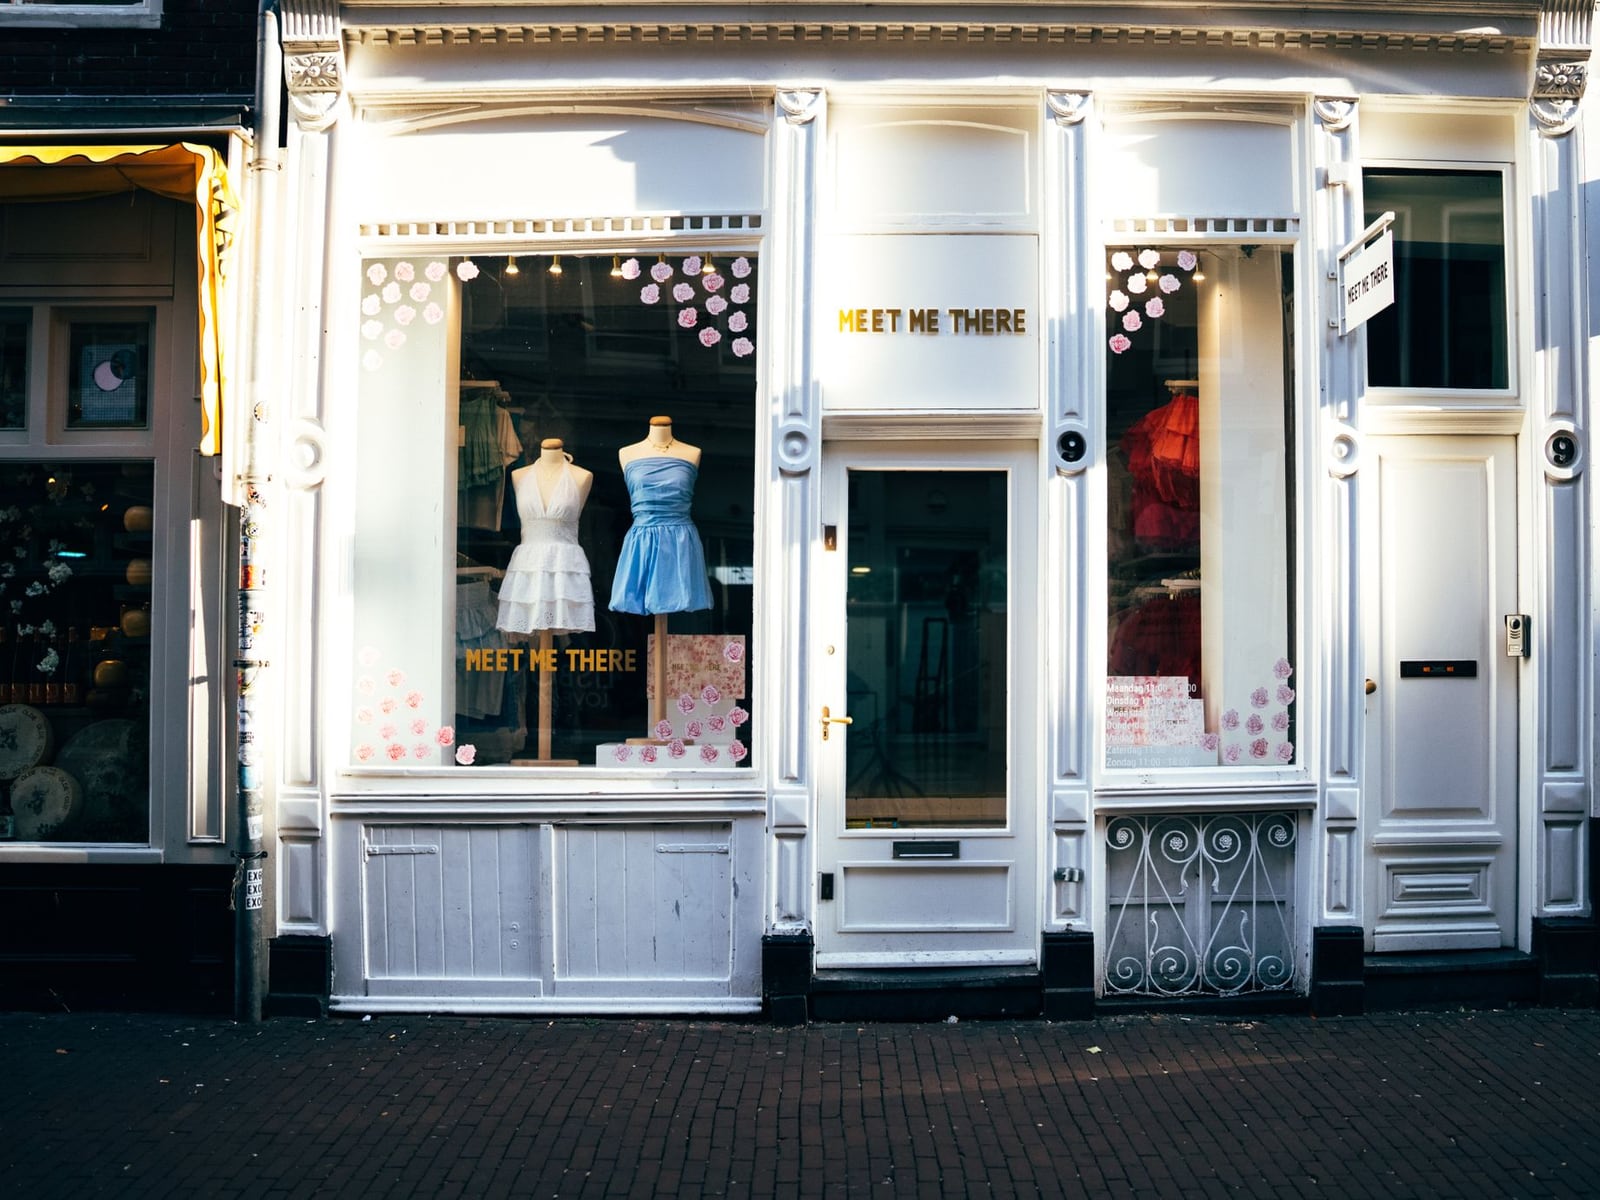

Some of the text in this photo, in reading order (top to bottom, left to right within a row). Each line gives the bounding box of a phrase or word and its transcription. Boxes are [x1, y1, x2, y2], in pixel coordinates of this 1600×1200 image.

[1348, 261, 1388, 304] MEET ME THERE
[838, 309, 1026, 333] MEET ME THERE
[1060, 431, 1084, 461] 9
[1552, 436, 1574, 464] 9
[465, 648, 636, 672] MEET ME THERE
[1107, 684, 1144, 694] Maandag
[1106, 757, 1136, 768] Zondag
